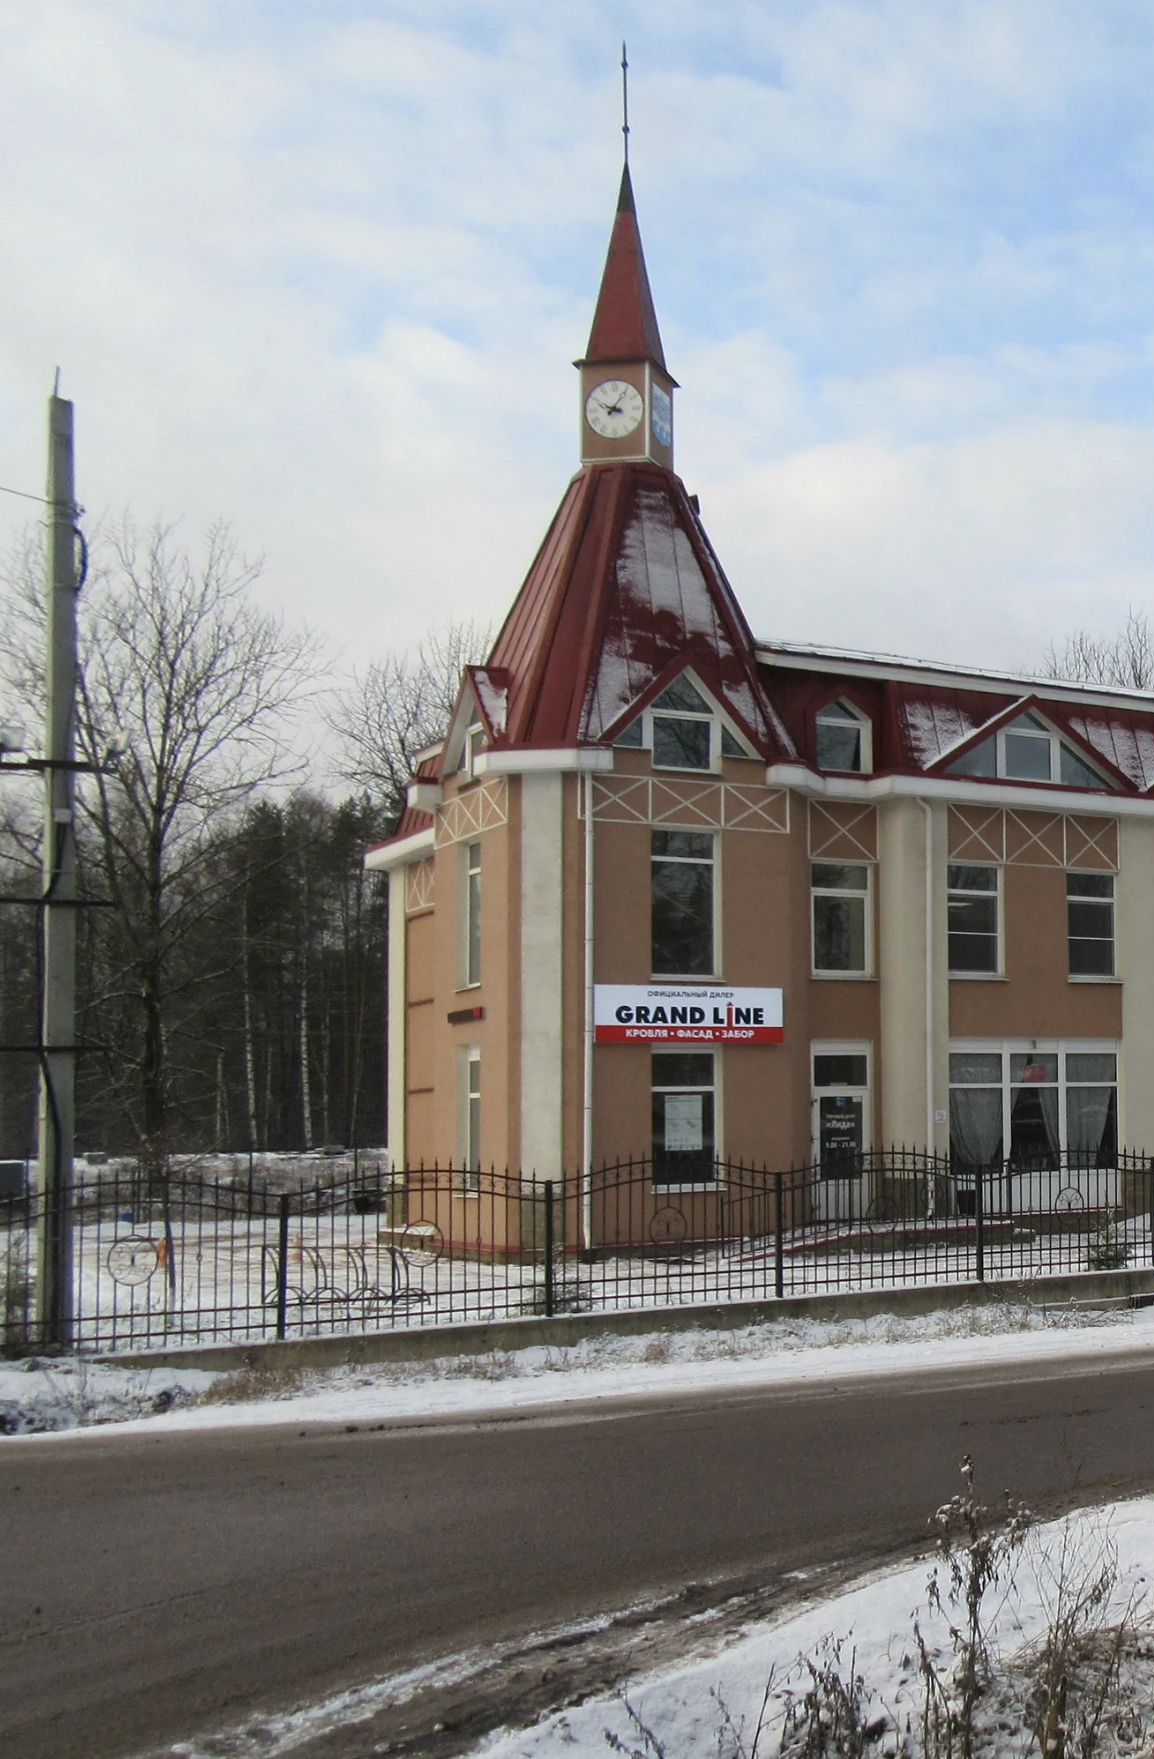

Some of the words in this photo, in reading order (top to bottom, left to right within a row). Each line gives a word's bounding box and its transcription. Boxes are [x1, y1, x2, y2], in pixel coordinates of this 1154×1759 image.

[647, 990, 708, 998] ОФИЦИАЛЬНЫЙ
[709, 991, 734, 999] ДИЛЕР
[615, 1005, 706, 1024] GRAND
[713, 1002, 764, 1026] LINE
[625, 1029, 668, 1038] КРОВЛЯ
[676, 1029, 713, 1039] ФАСАД
[721, 1030, 755, 1038] ЗАБОР
